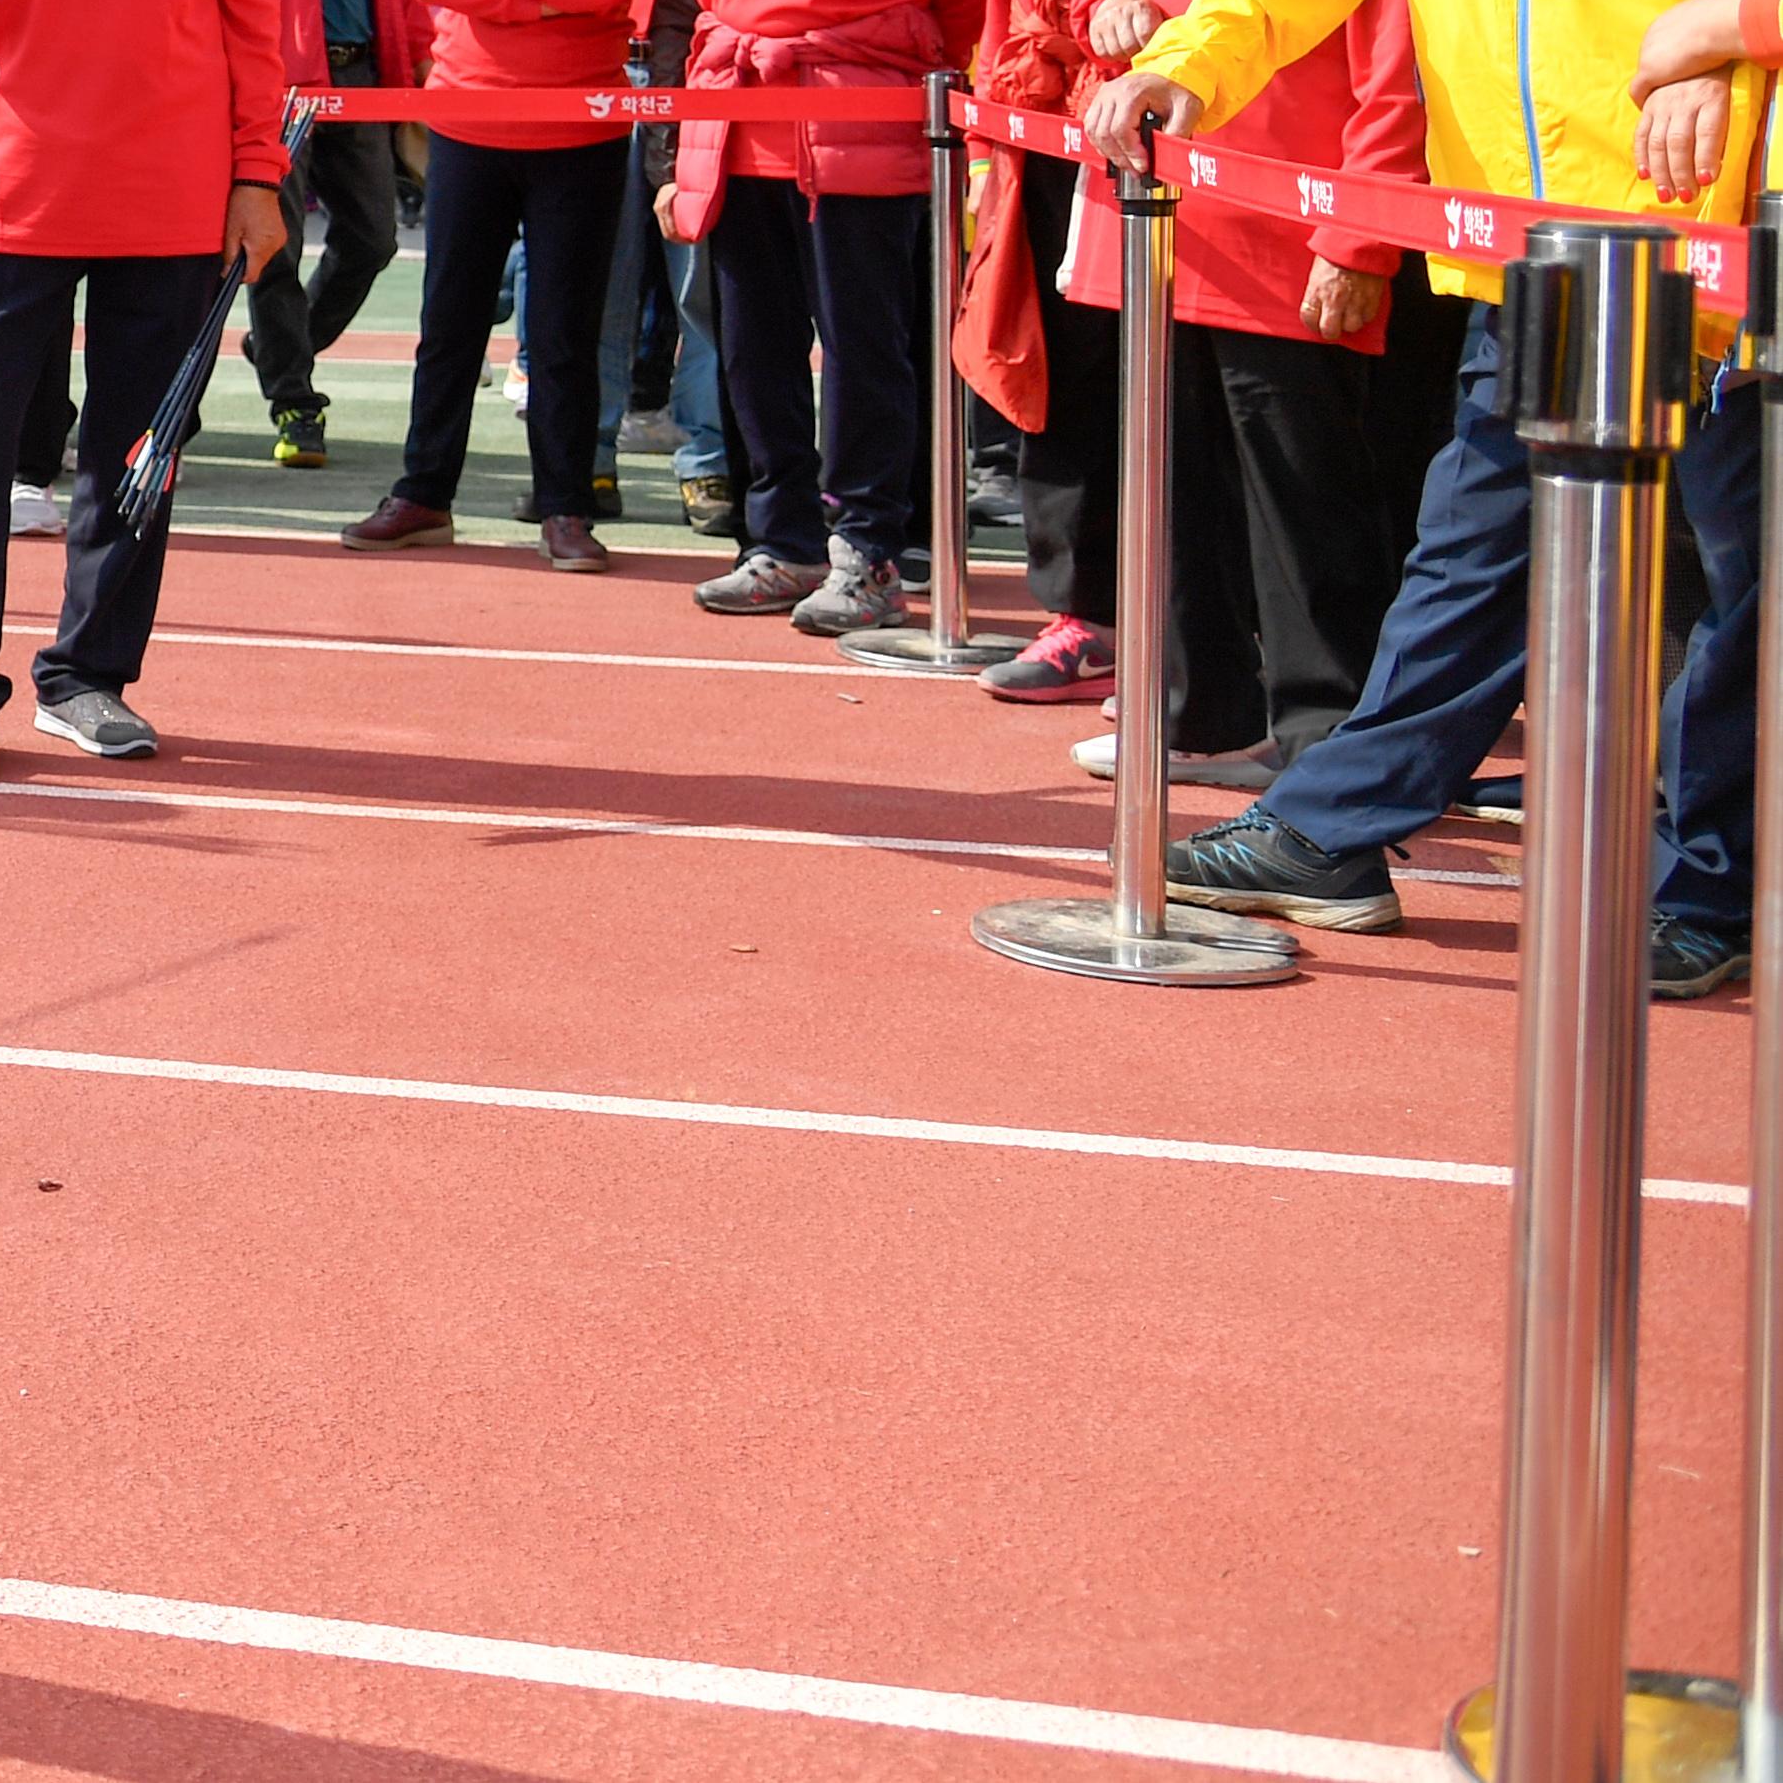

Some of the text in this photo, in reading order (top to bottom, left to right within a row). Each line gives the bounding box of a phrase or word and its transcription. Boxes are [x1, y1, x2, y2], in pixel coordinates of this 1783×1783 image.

[621, 94, 674, 116] 화천군
[1310, 178, 1335, 216] 화천군
[1463, 206, 1495, 249] 화천군
